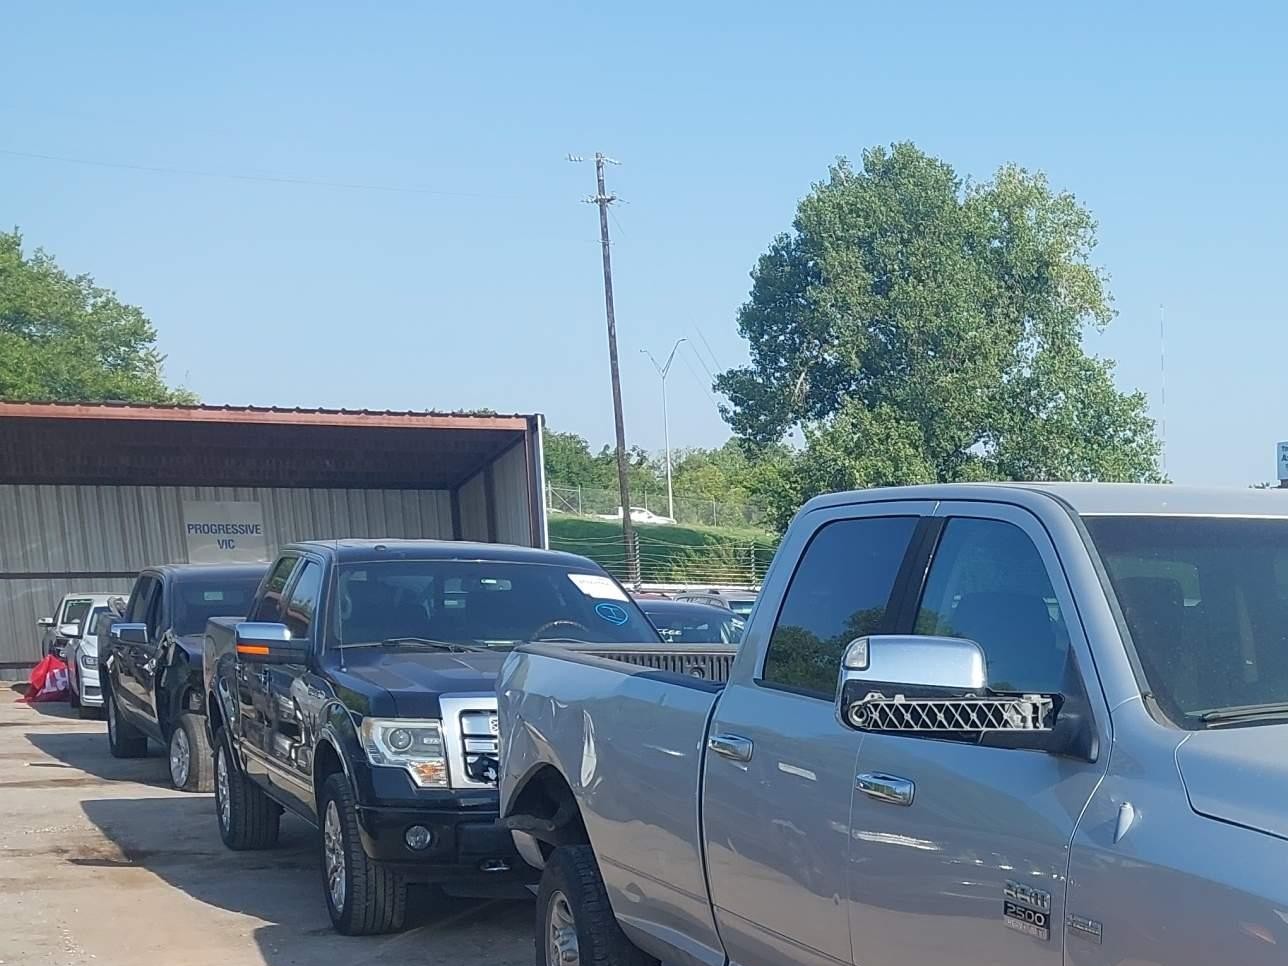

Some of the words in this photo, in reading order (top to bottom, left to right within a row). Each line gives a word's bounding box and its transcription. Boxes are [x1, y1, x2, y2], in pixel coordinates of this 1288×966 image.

[187, 523, 261, 534] PROGRESSIVE
[217, 539, 235, 549] VIC
[1006, 903, 1045, 926] 2500
